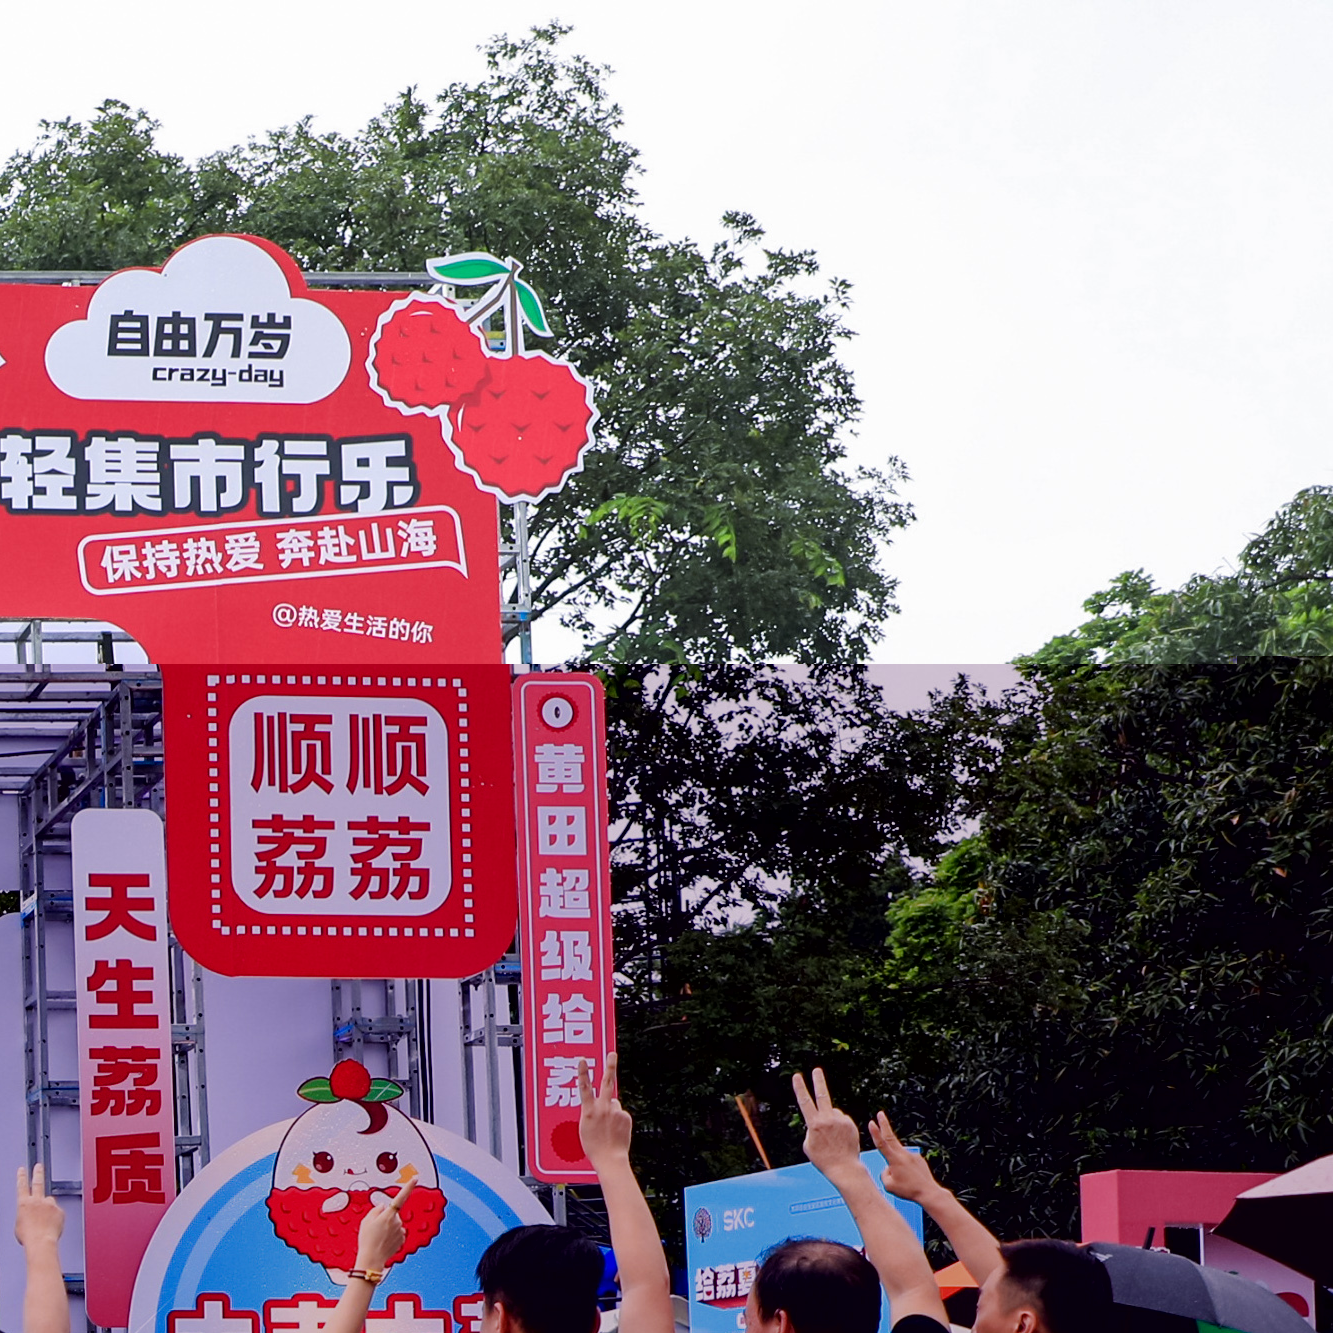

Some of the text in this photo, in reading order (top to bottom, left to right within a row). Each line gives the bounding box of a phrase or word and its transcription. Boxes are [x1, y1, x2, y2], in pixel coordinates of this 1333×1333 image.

[106, 309, 293, 359] 自由万岁
[151, 363, 284, 388] crazy-day
[101, 519, 437, 583] 保持热爱 奔赴山海
[271, 602, 435, 645] @热爱生活的你
[250, 711, 429, 797] 顺顺
[250, 814, 432, 901] 荔荔
[533, 742, 599, 1108] 黄田超级给荔
[84, 872, 167, 1204] 天生荔质
[723, 1207, 755, 1232] SKC
